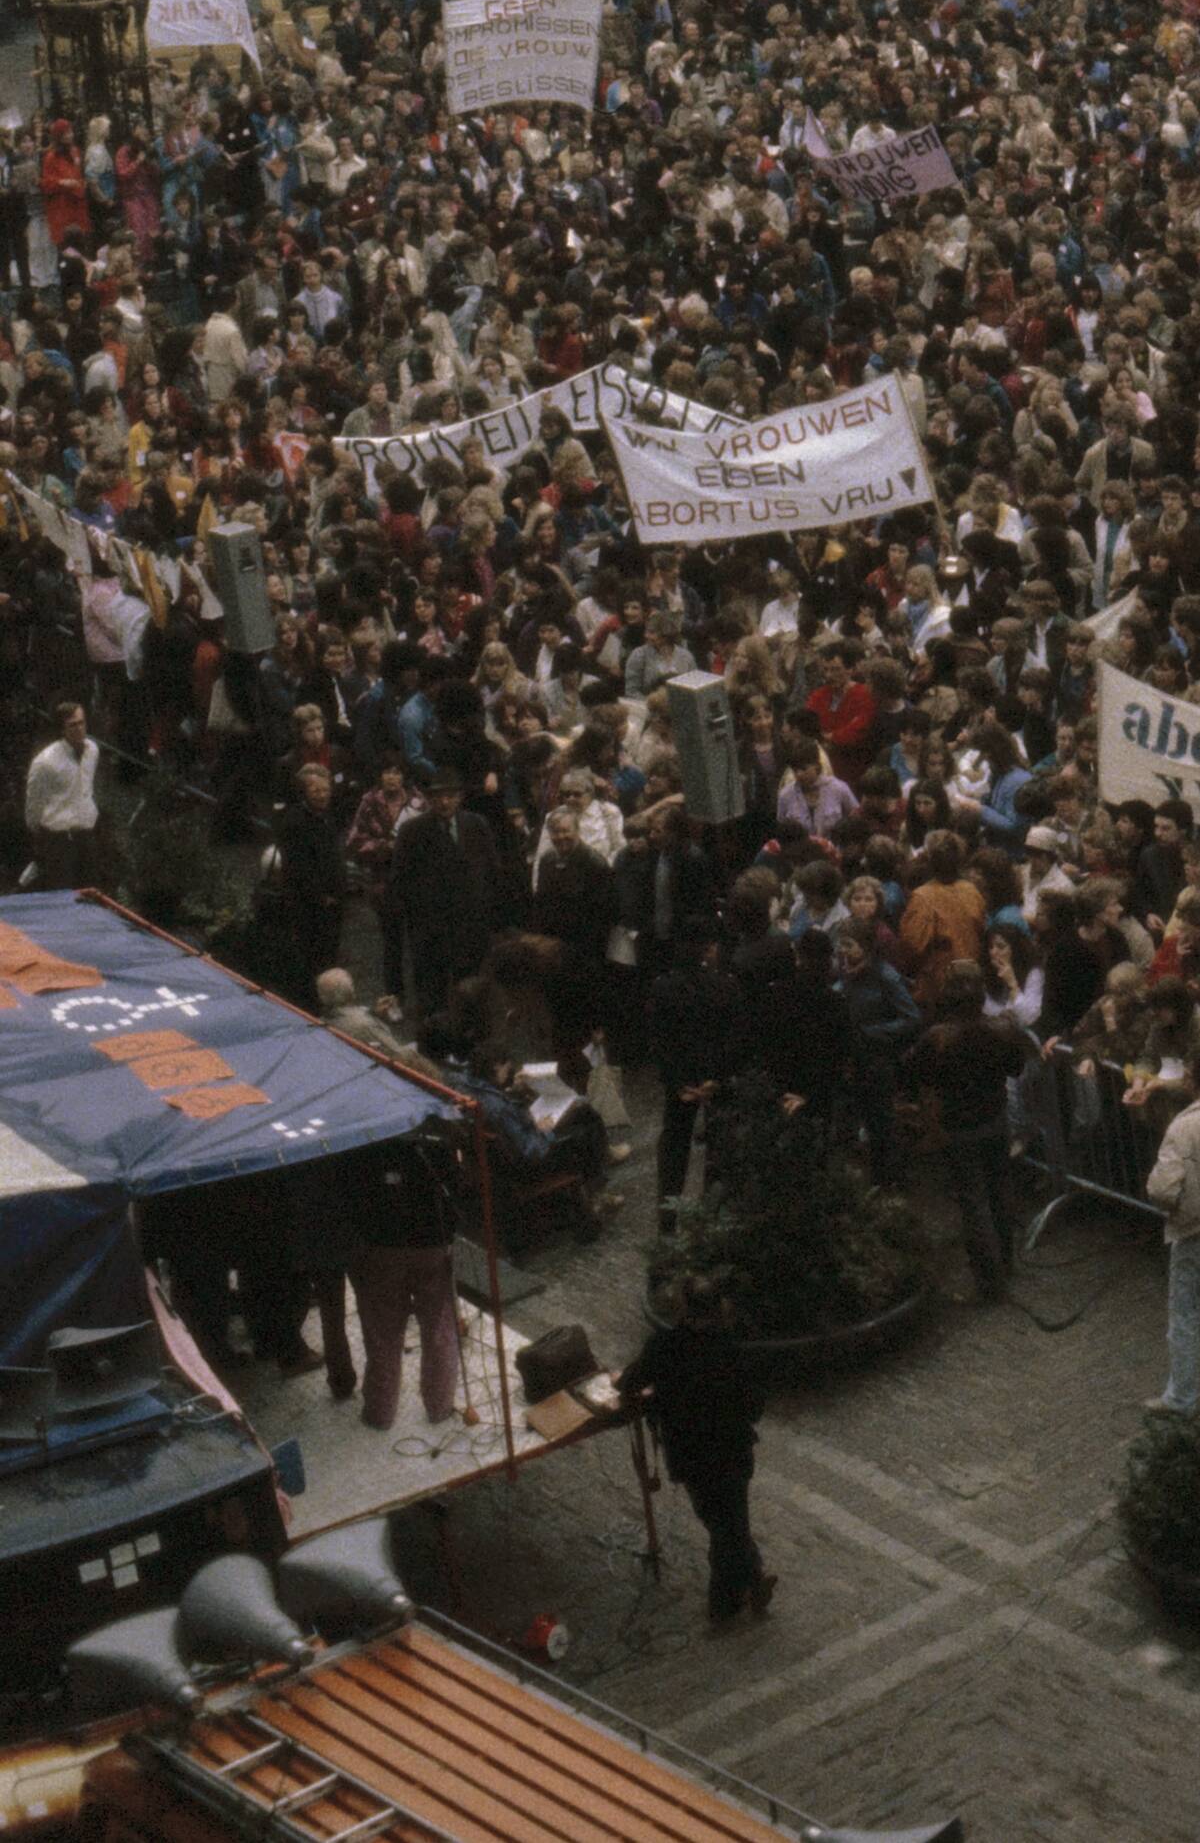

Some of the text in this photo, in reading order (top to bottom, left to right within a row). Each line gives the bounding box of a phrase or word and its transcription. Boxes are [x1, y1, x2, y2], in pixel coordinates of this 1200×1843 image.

[499, 38, 593, 59] VROUW
[828, 128, 942, 175] VROUWEN
[704, 389, 893, 460] VROUWEN
[695, 459, 807, 491] EISEN
[632, 496, 800, 528] ABORTUS
